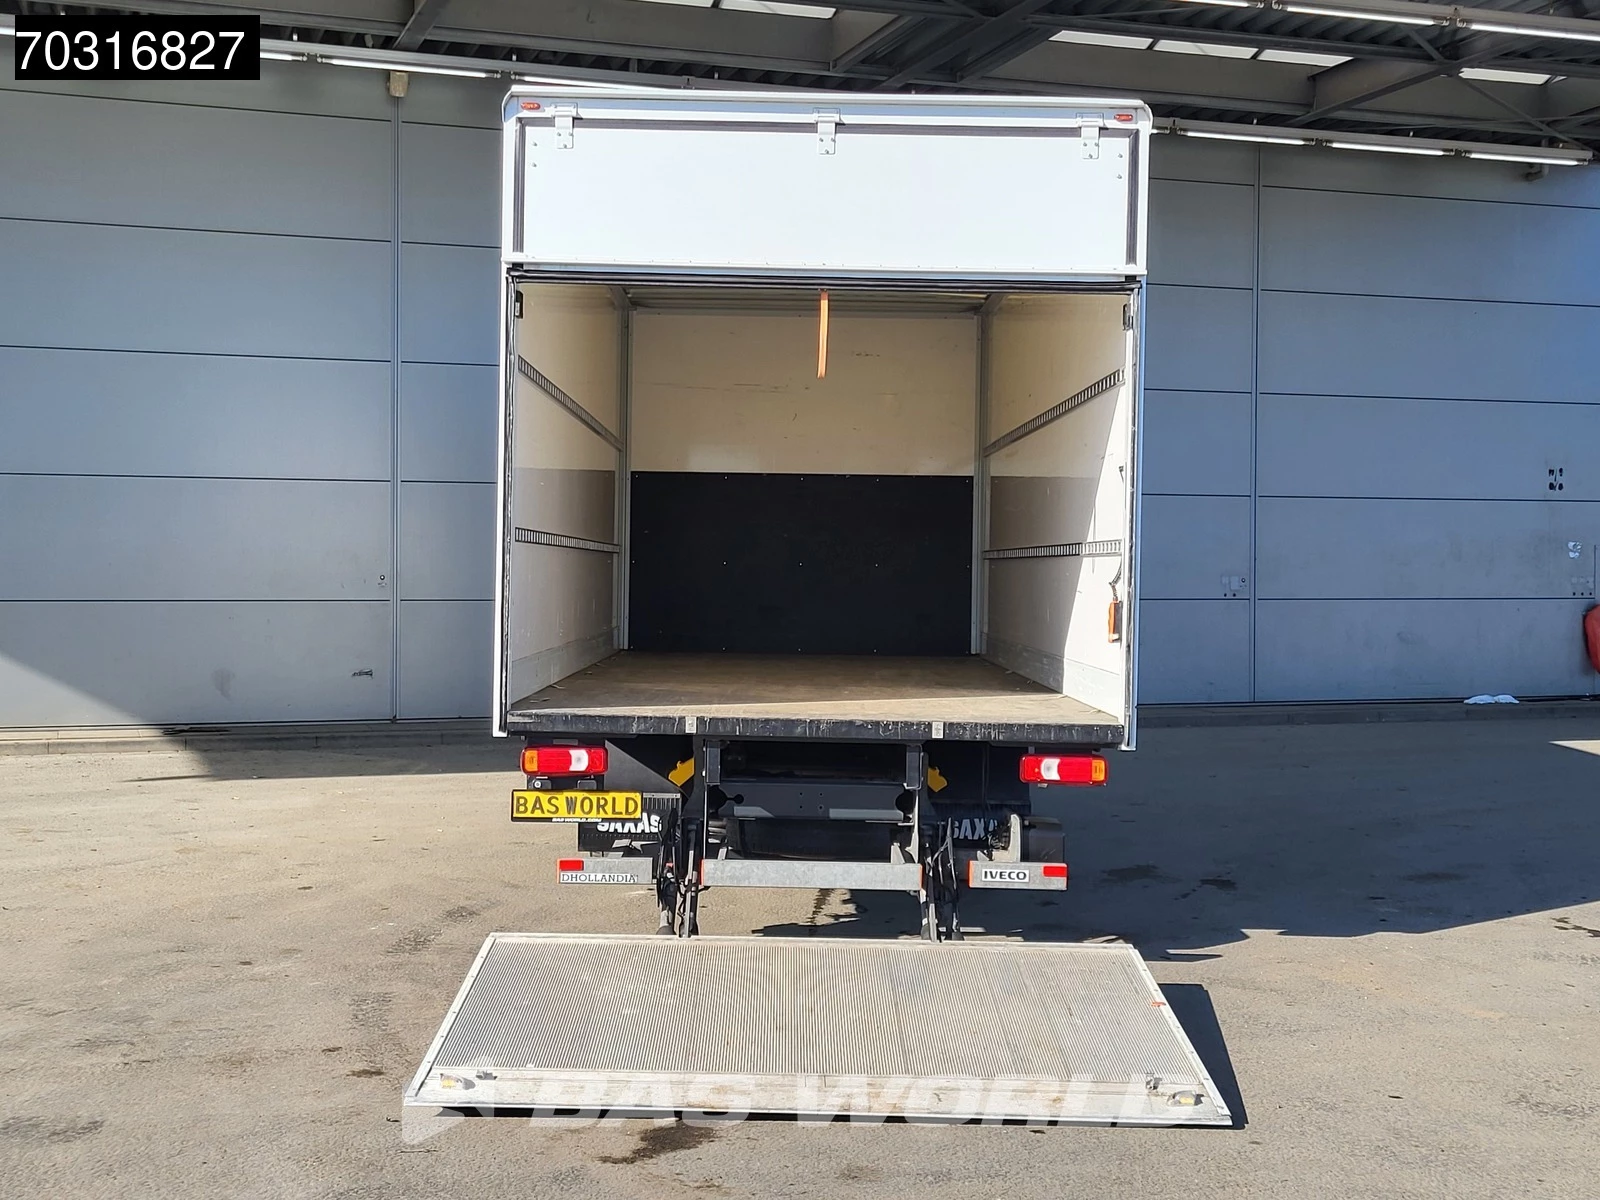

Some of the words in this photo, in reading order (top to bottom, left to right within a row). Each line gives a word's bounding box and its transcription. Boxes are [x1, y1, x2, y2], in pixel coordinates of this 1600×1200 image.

[515, 795, 560, 815] BAS
[565, 796, 639, 816] WORLD
[561, 873, 637, 883] DHOLLANDIA
[983, 870, 1027, 880] IVECO
